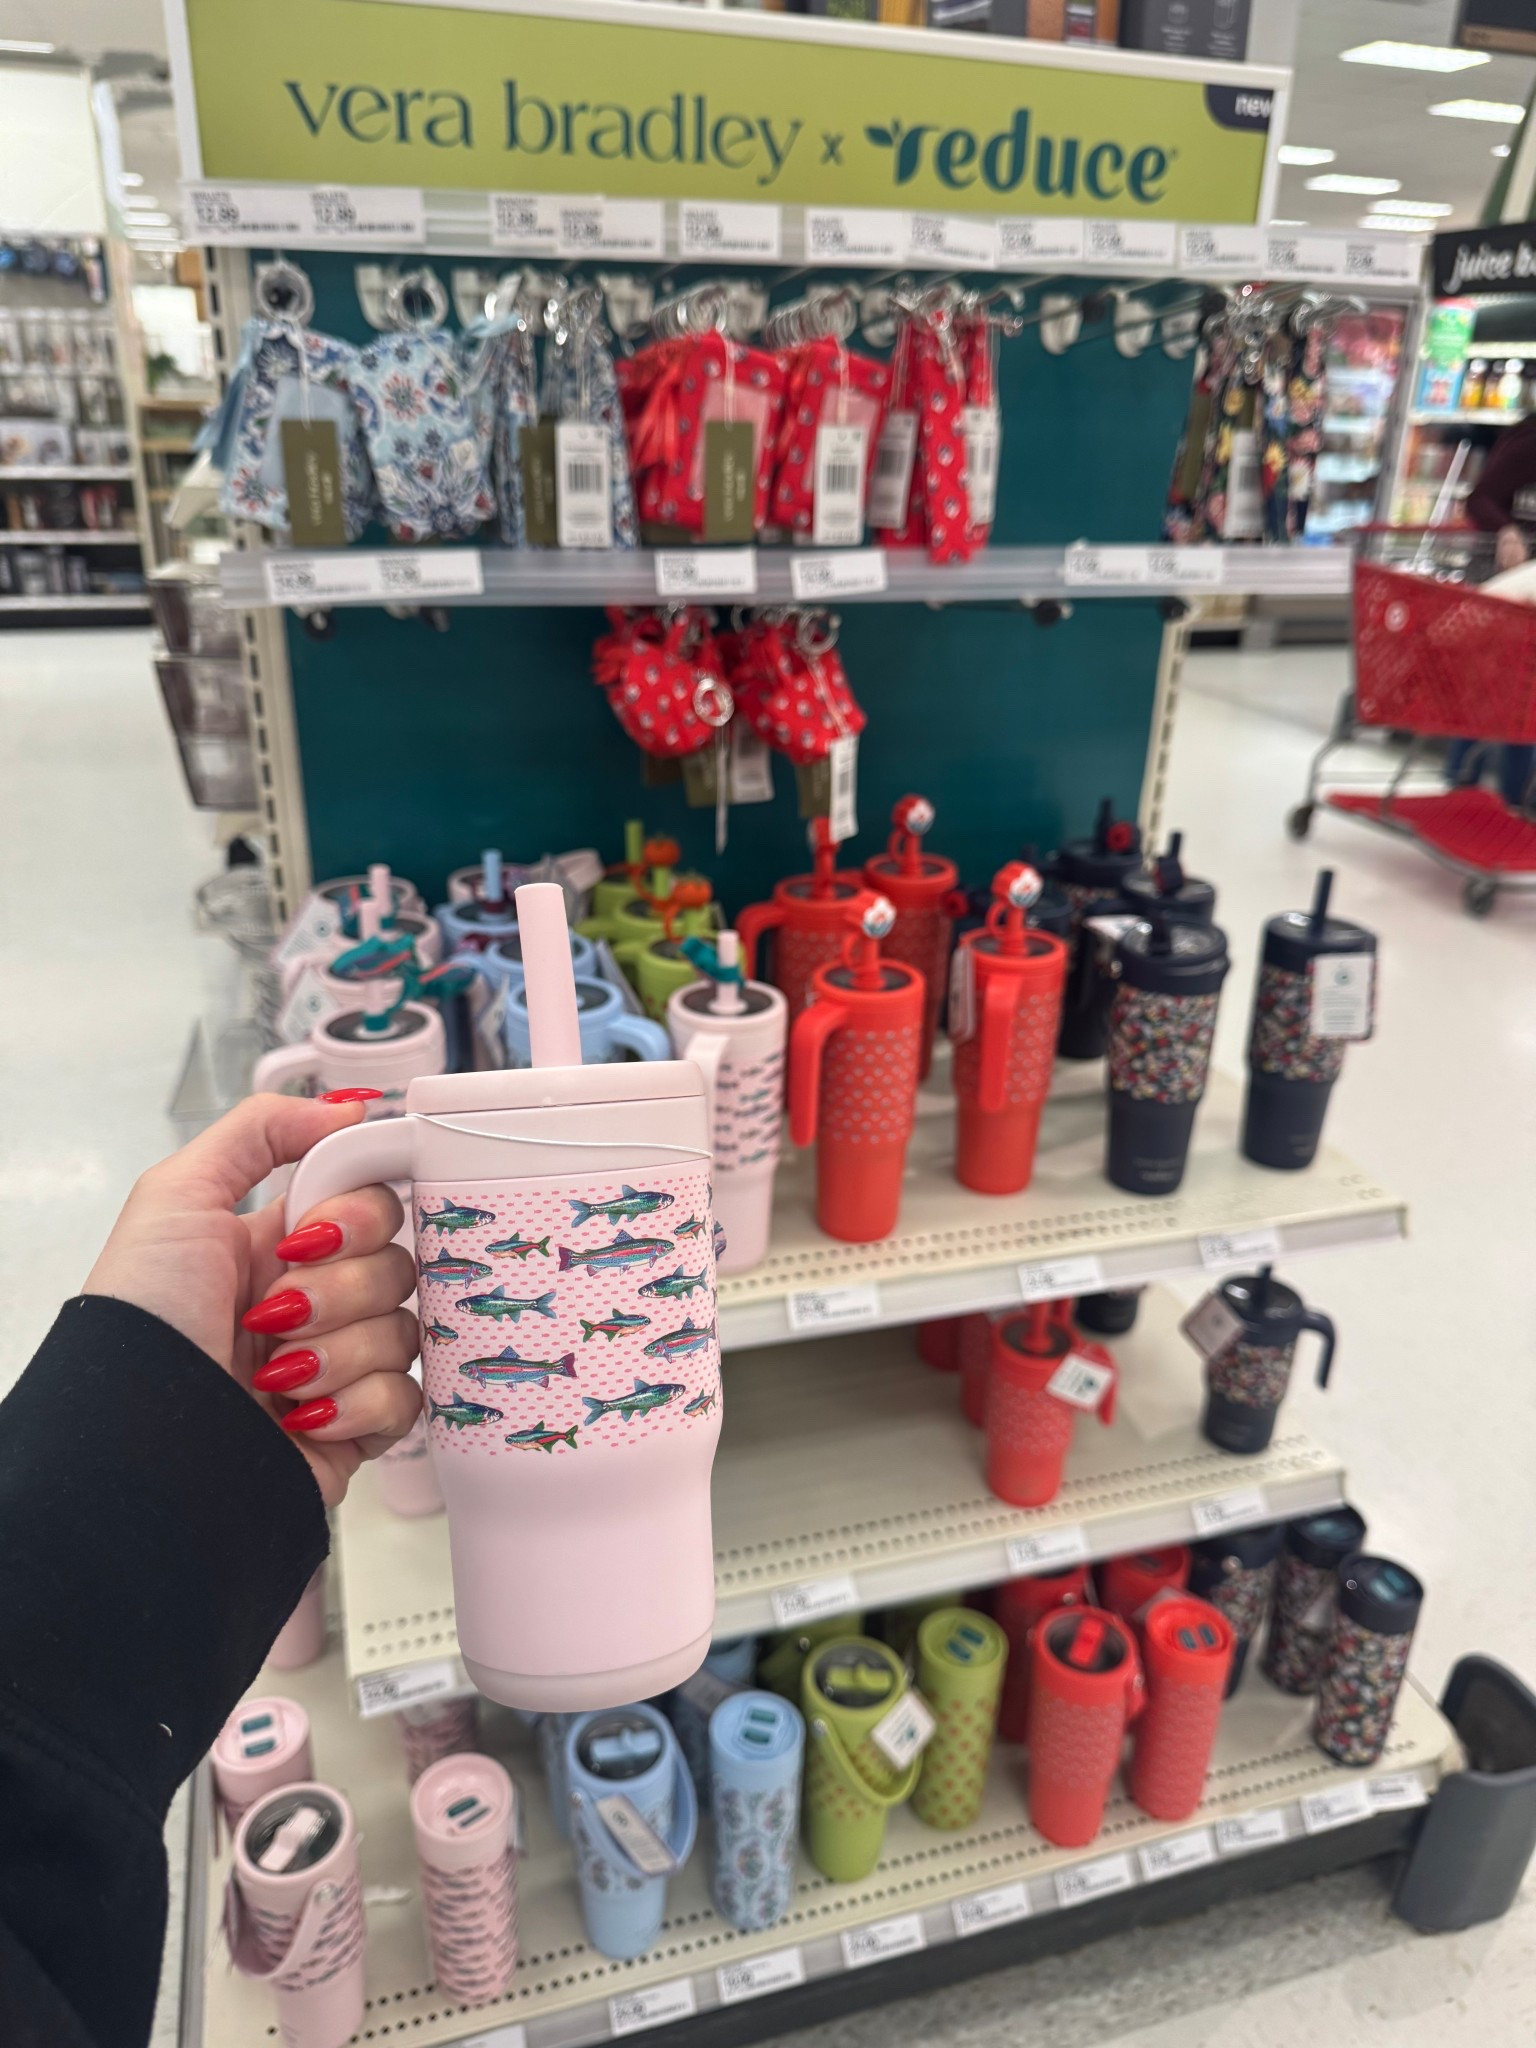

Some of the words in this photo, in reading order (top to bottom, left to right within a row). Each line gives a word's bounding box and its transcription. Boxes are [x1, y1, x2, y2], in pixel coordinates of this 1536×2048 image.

[1234, 95, 1273, 118] new
[284, 80, 474, 149] vera
[503, 79, 803, 186] bradley
[821, 133, 844, 165] x
[866, 107, 1168, 204] reduce
[1442, 244, 1512, 294] juice
